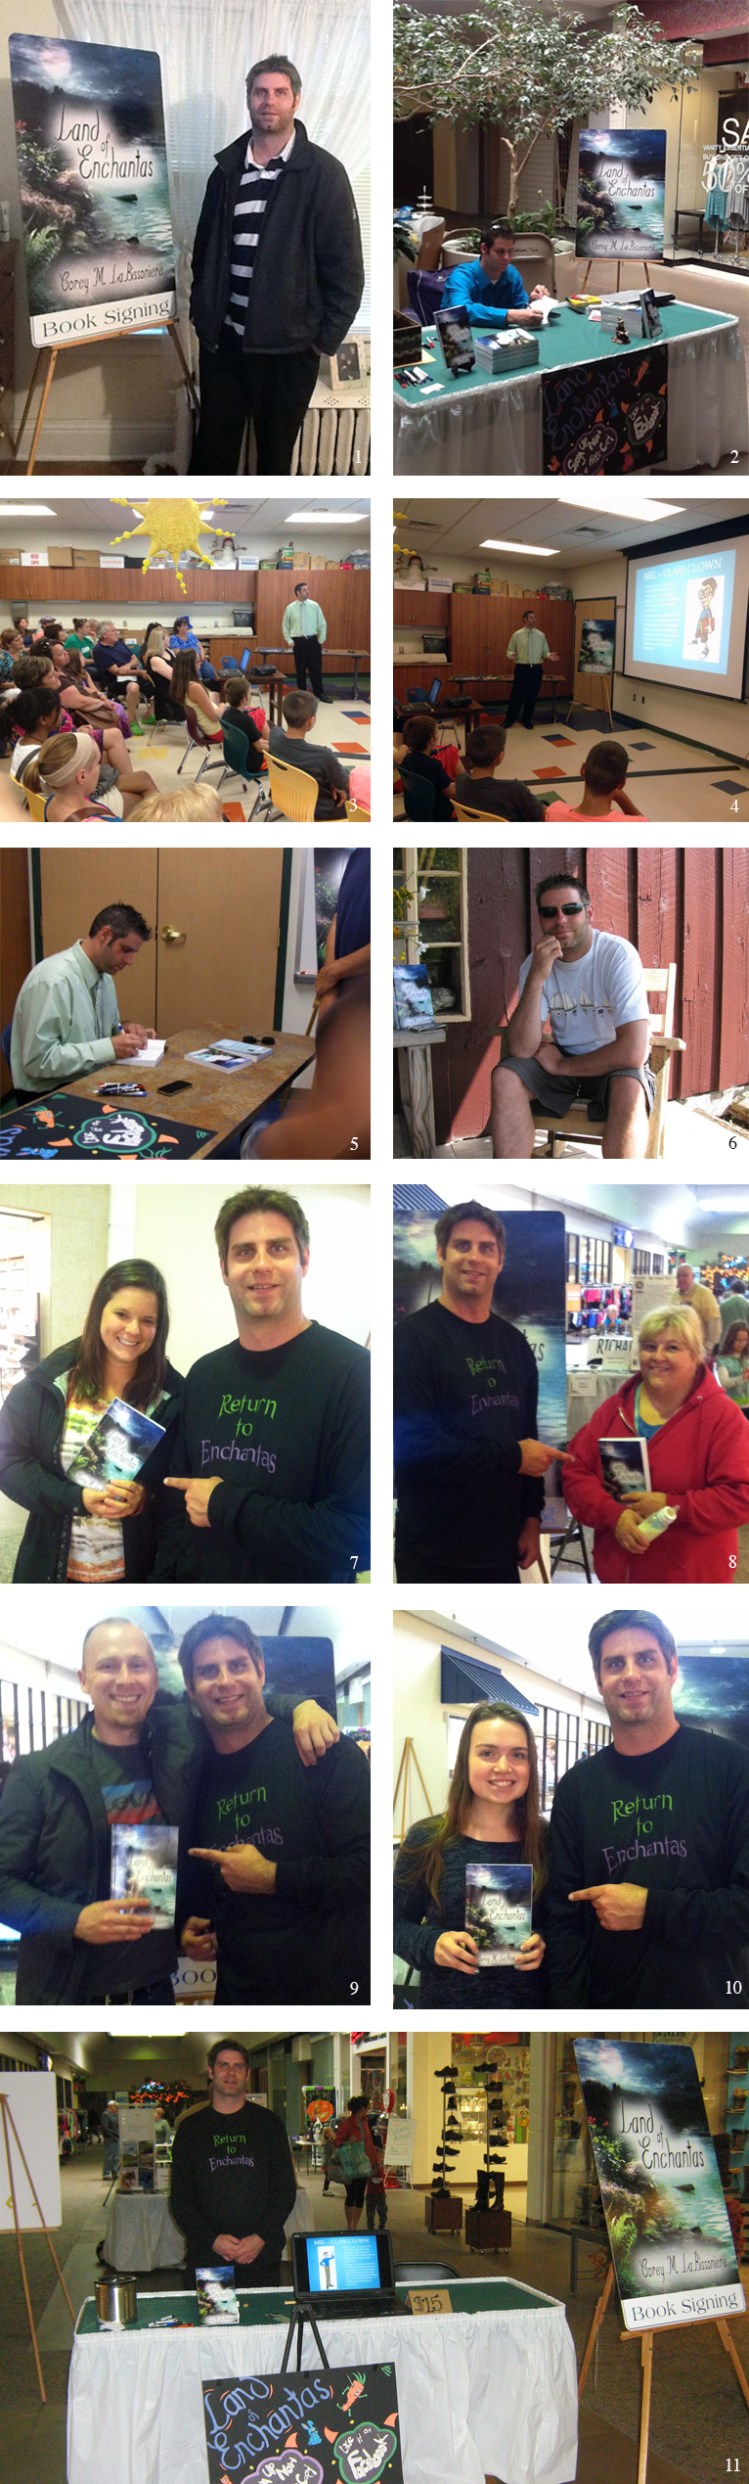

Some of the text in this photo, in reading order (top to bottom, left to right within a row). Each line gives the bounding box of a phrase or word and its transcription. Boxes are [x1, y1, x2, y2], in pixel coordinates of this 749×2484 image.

[54, 104, 101, 142] Land
[101, 132, 111, 159] of
[77, 144, 154, 180] Enchantas
[598, 160, 624, 178] Land
[608, 179, 655, 197] Enchantas
[59, 270, 90, 295] Corey
[42, 298, 170, 338] Book Signing
[687, 558, 722, 573] CLOWN
[219, 1394, 277, 1420] Return
[235, 1418, 254, 1438] to
[201, 1440, 277, 1474] Enchantas
[216, 1786, 268, 1821] Return
[611, 1794, 673, 1825] Return
[235, 1813, 250, 1831] to
[636, 1818, 653, 1837] to
[601, 1836, 688, 1877] Enchantas
[482, 1891, 502, 1906] Land
[489, 1907, 526, 1921] Enchantas
[619, 2097, 654, 2133] Land
[213, 2134, 246, 2147] Return
[657, 2124, 664, 2149] of
[227, 2145, 236, 2155] to
[638, 2136, 705, 2169] Enchantas
[208, 2155, 255, 2173] Enchantas
[640, 2258, 665, 2282] Corey
[667, 2255, 679, 2275] M
[413, 2294, 443, 2313] $15
[631, 2292, 739, 2322] Book Signing
[204, 2376, 270, 2435] Land
[207, 2378, 331, 2470] Enchantas
